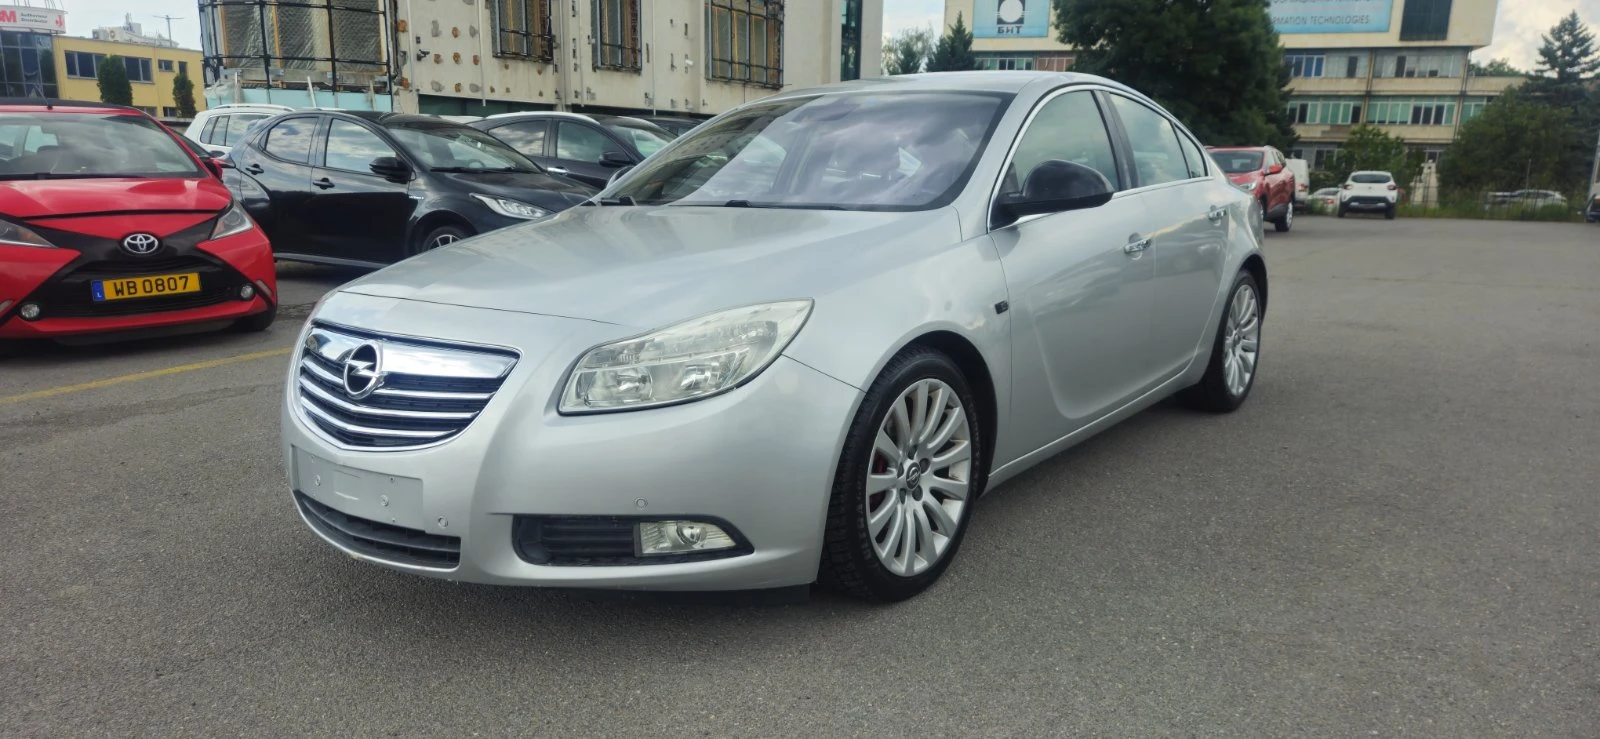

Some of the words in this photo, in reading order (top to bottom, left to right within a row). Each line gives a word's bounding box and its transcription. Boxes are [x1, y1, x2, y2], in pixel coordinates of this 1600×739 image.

[1310, 14, 1370, 25] TECHNOLOGIES
[113, 281, 138, 296] WB
[142, 275, 189, 294] 0807
